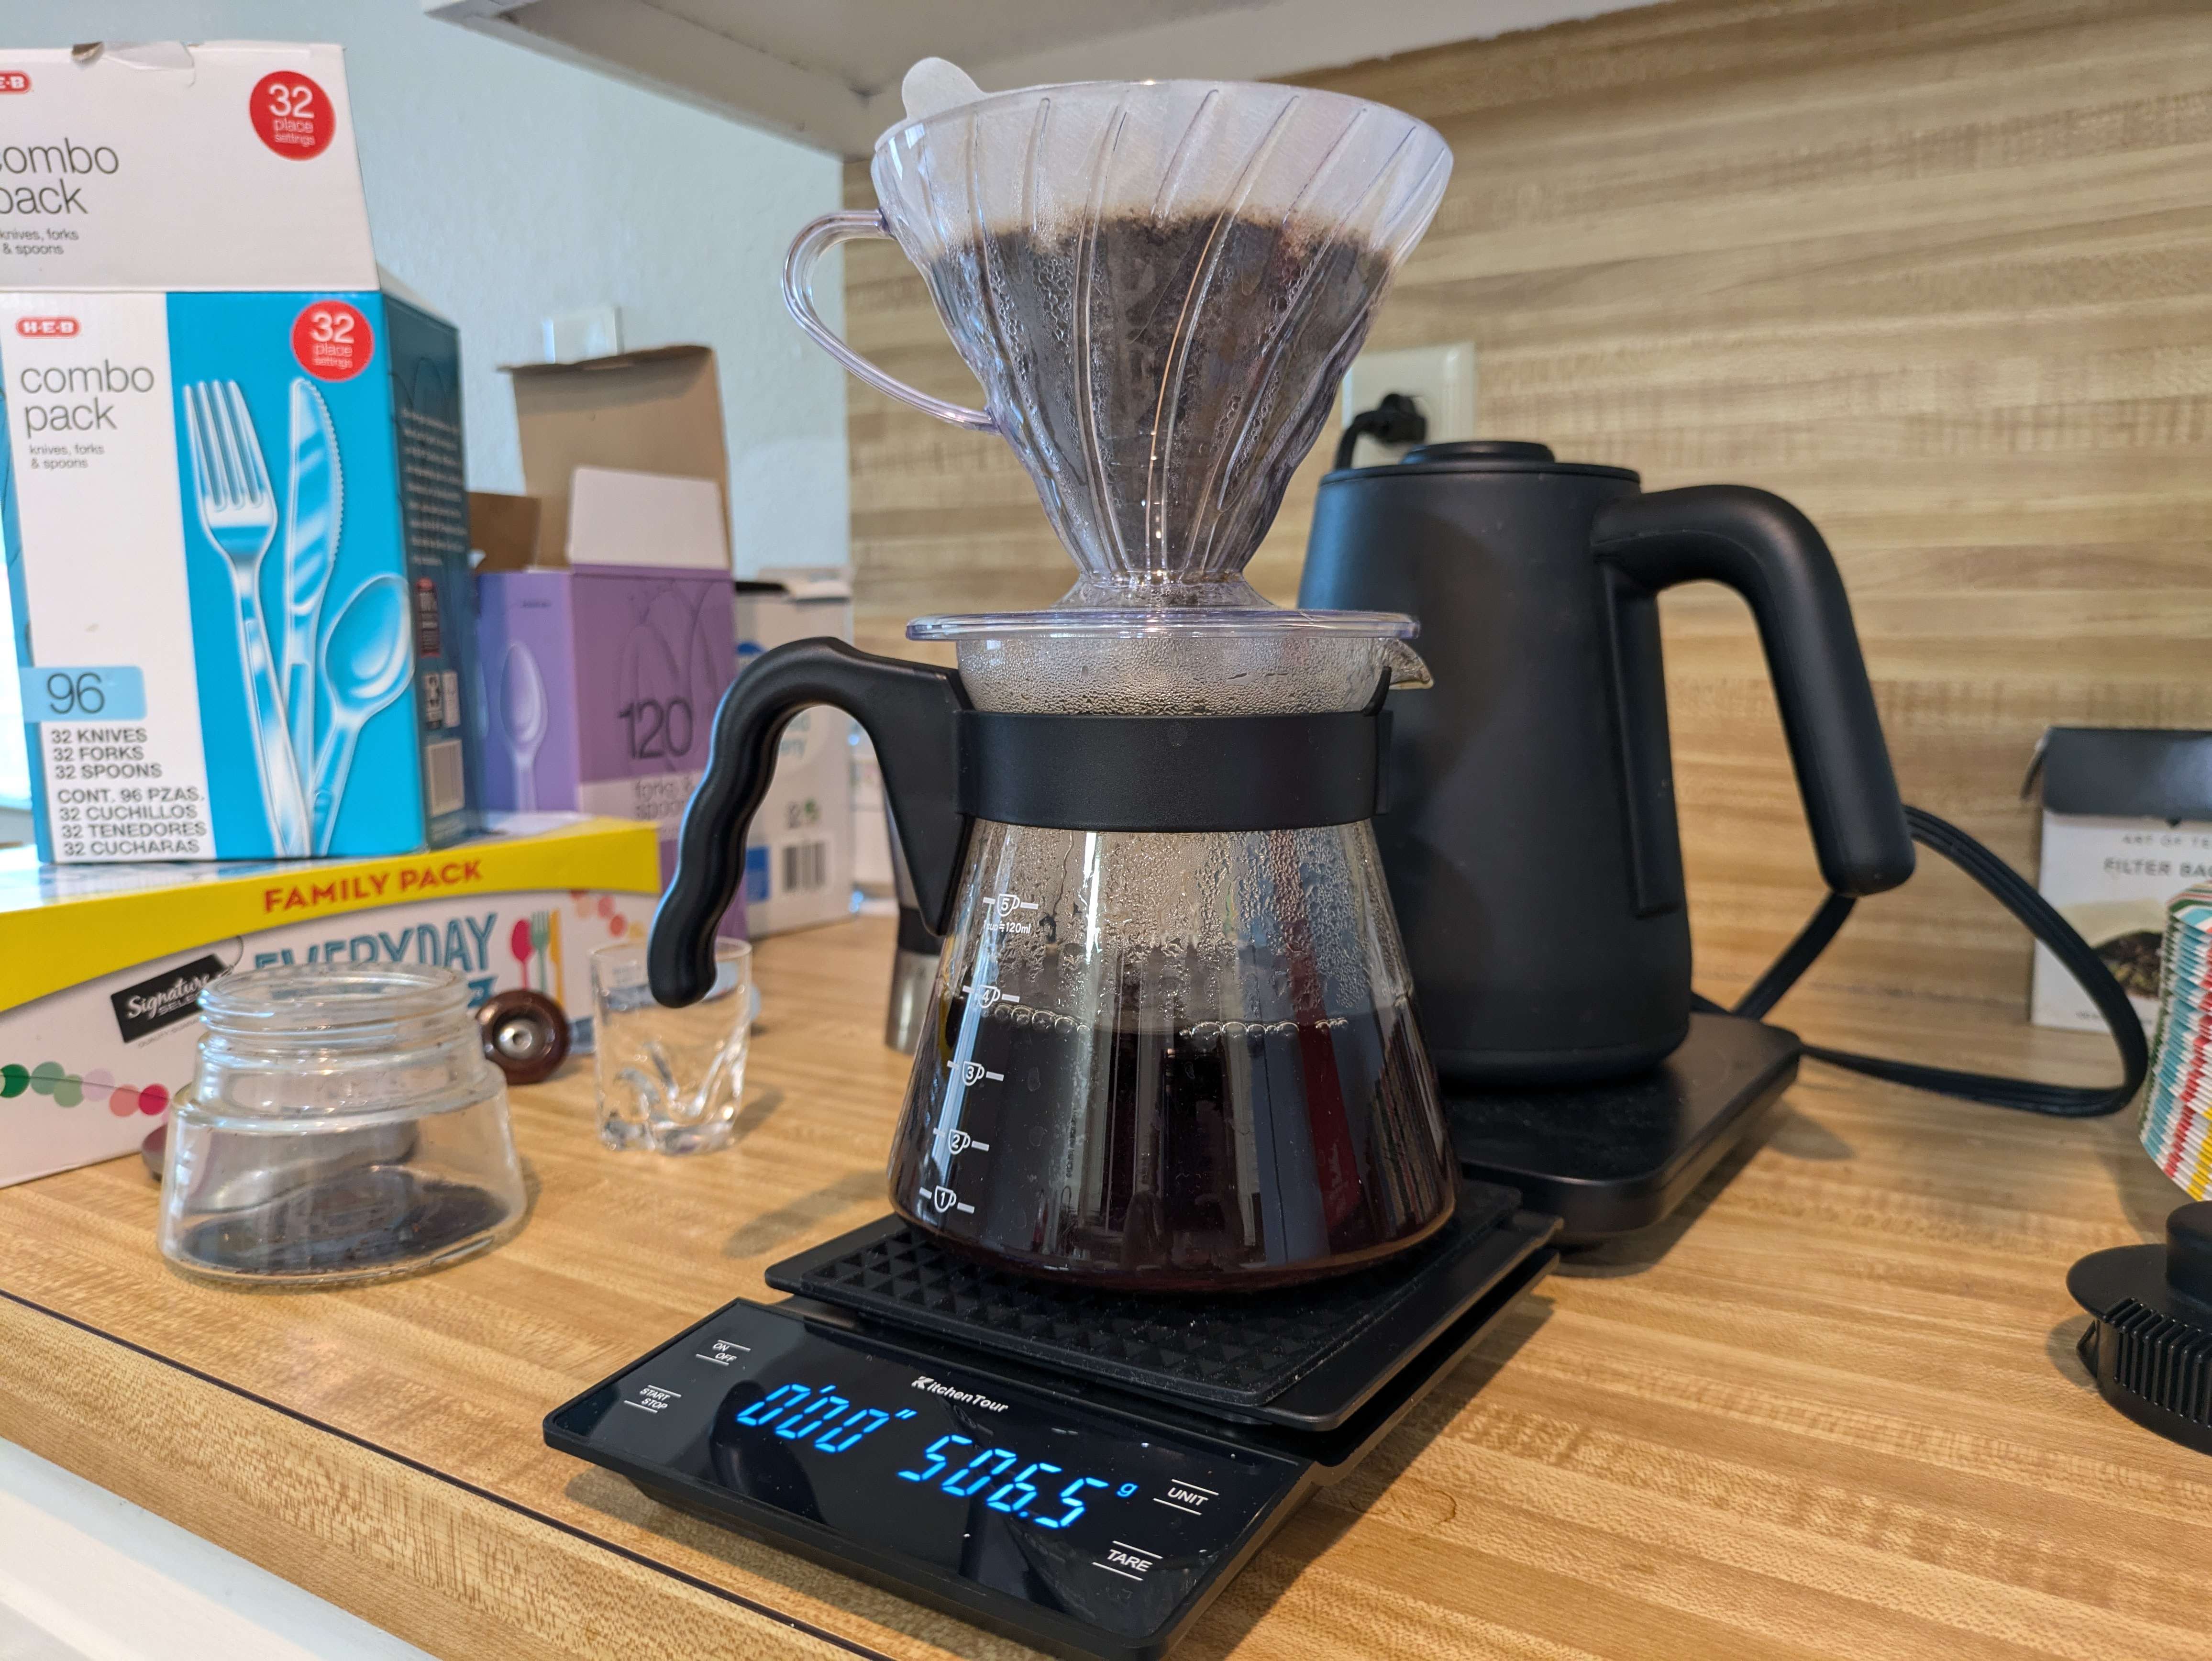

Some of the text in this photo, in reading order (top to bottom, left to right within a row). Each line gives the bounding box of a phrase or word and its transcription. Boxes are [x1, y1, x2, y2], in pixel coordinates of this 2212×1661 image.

[269, 83, 315, 119] 32
[274, 118, 314, 133] place
[0, 137, 119, 174] ombo
[47, 228, 79, 240] forks
[3, 243, 64, 256] & spoons
[310, 312, 355, 344] 32
[314, 343, 353, 357] place
[20, 358, 155, 394] combo
[24, 397, 118, 439] pack
[75, 443, 105, 454] forks
[31, 458, 88, 472] & spoons
[47, 673, 105, 714] 96
[51, 728, 148, 744] 32 KNIVES
[617, 699, 693, 759] 120
[53, 746, 144, 762] 32 FORKS
[55, 763, 162, 779] 32 SPOONS
[58, 786, 205, 804] CONT. 96 PZAS.
[60, 804, 198, 821] 32 CUCHILLOS
[61, 821, 207, 839] 32 TENEDORES
[64, 839, 200, 856] 32 CUCHARAS
[2104, 858, 2170, 876] FILTER
[263, 859, 482, 914] FAMILY PACK
[1001, 897, 1010, 911] 5
[125, 973, 210, 1020] Signature
[982, 990, 989, 1003] 4
[966, 1066, 974, 1080] 3
[951, 1134, 961, 1149] 2
[940, 1192, 946, 1207] 1
[712, 1342, 730, 1352] ON
[715, 1352, 737, 1362] OFF
[640, 1388, 671, 1402] START
[911, 1376, 1008, 1413] KitchenTour
[641, 1398, 668, 1410] STOP
[896, 1434, 1139, 1528] 506.5 g
[1167, 1487, 1209, 1506] UNIT
[1106, 1549, 1153, 1572] TARE
